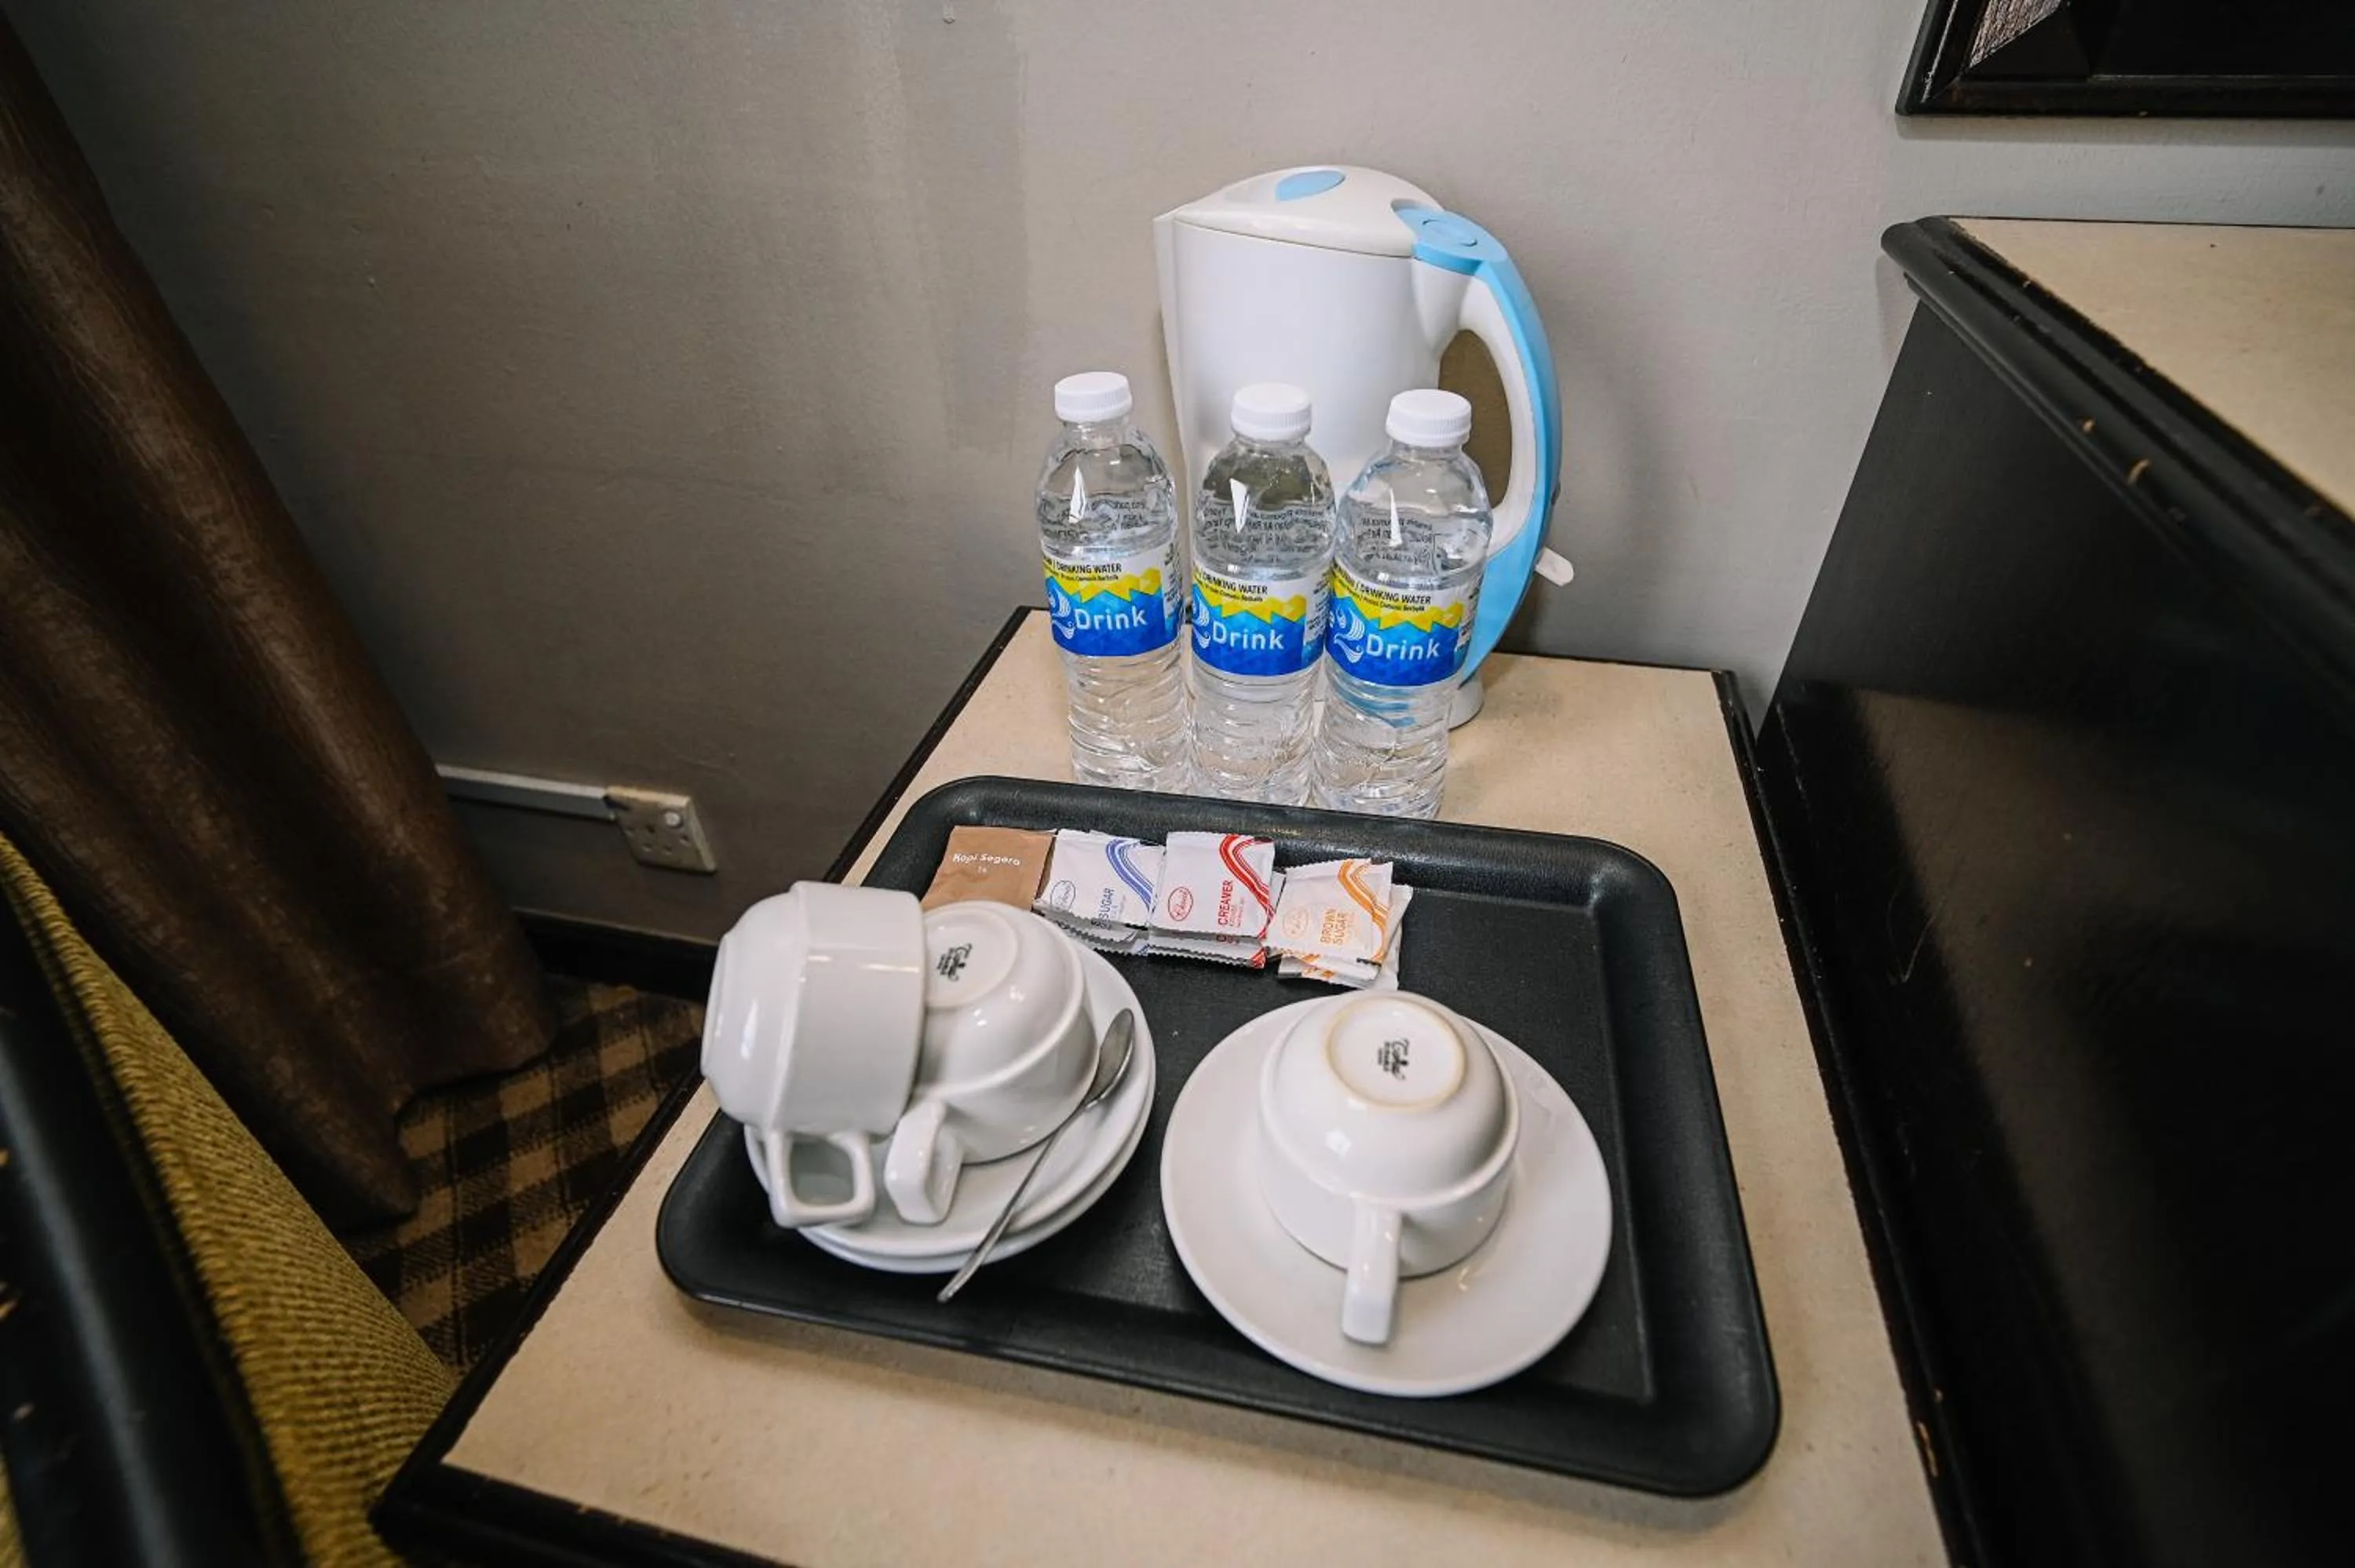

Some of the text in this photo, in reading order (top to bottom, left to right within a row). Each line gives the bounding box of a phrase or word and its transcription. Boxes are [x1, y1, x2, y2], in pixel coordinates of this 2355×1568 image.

[1093, 563, 1123, 574] WATER
[1238, 583, 1268, 595] WATER
[1401, 594, 1432, 605] WATER
[1074, 604, 1148, 631] Drink
[1212, 620, 1285, 651] Drink
[1366, 633, 1440, 661] Drink
[1098, 887, 1115, 919] SUGAR
[1320, 908, 1336, 943] BROWN
